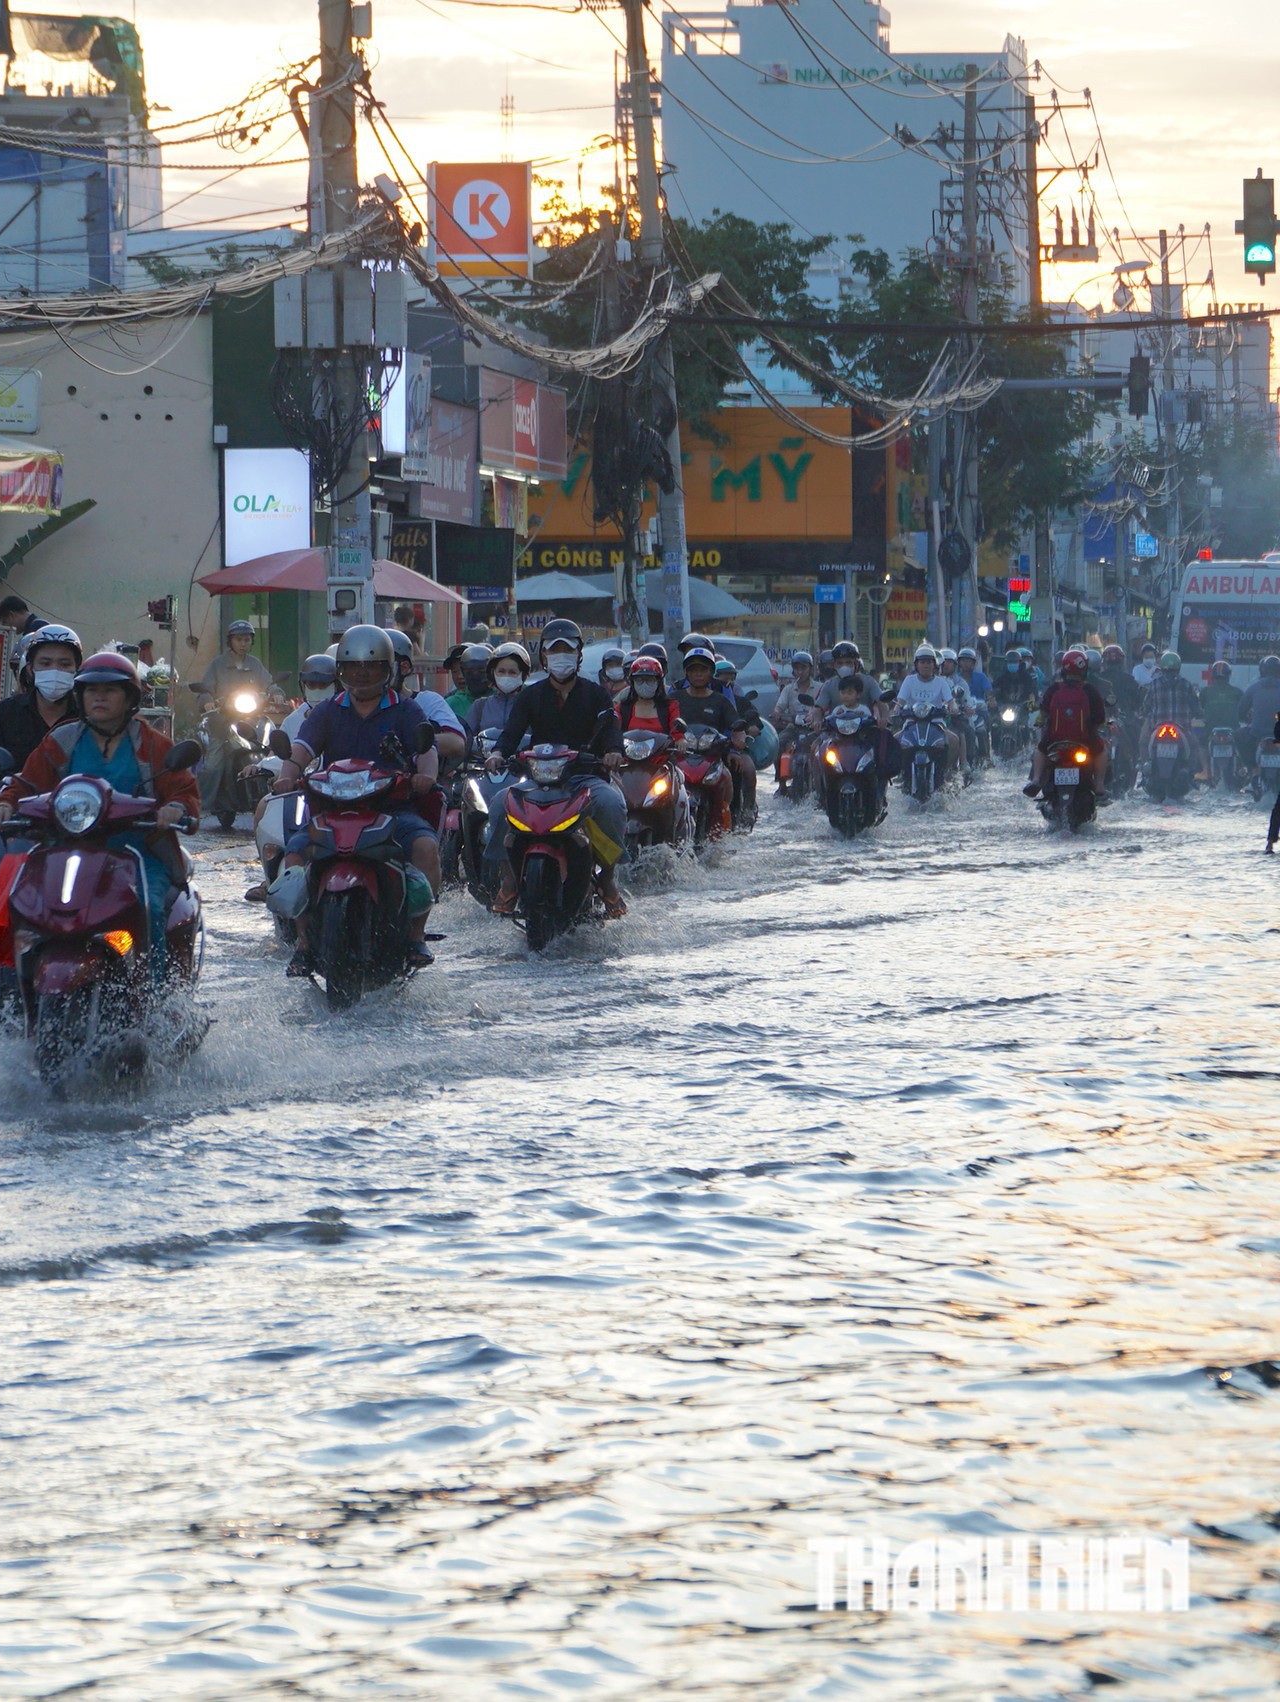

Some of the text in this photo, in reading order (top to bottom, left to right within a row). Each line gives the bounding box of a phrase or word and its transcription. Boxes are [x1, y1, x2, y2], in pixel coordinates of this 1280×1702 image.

[795, 68, 829, 82] NHA
[840, 68, 893, 83] KHOA
[710, 437, 813, 502] MỸ
[233, 495, 279, 513] OLA
[540, 545, 604, 569] CÔNG
